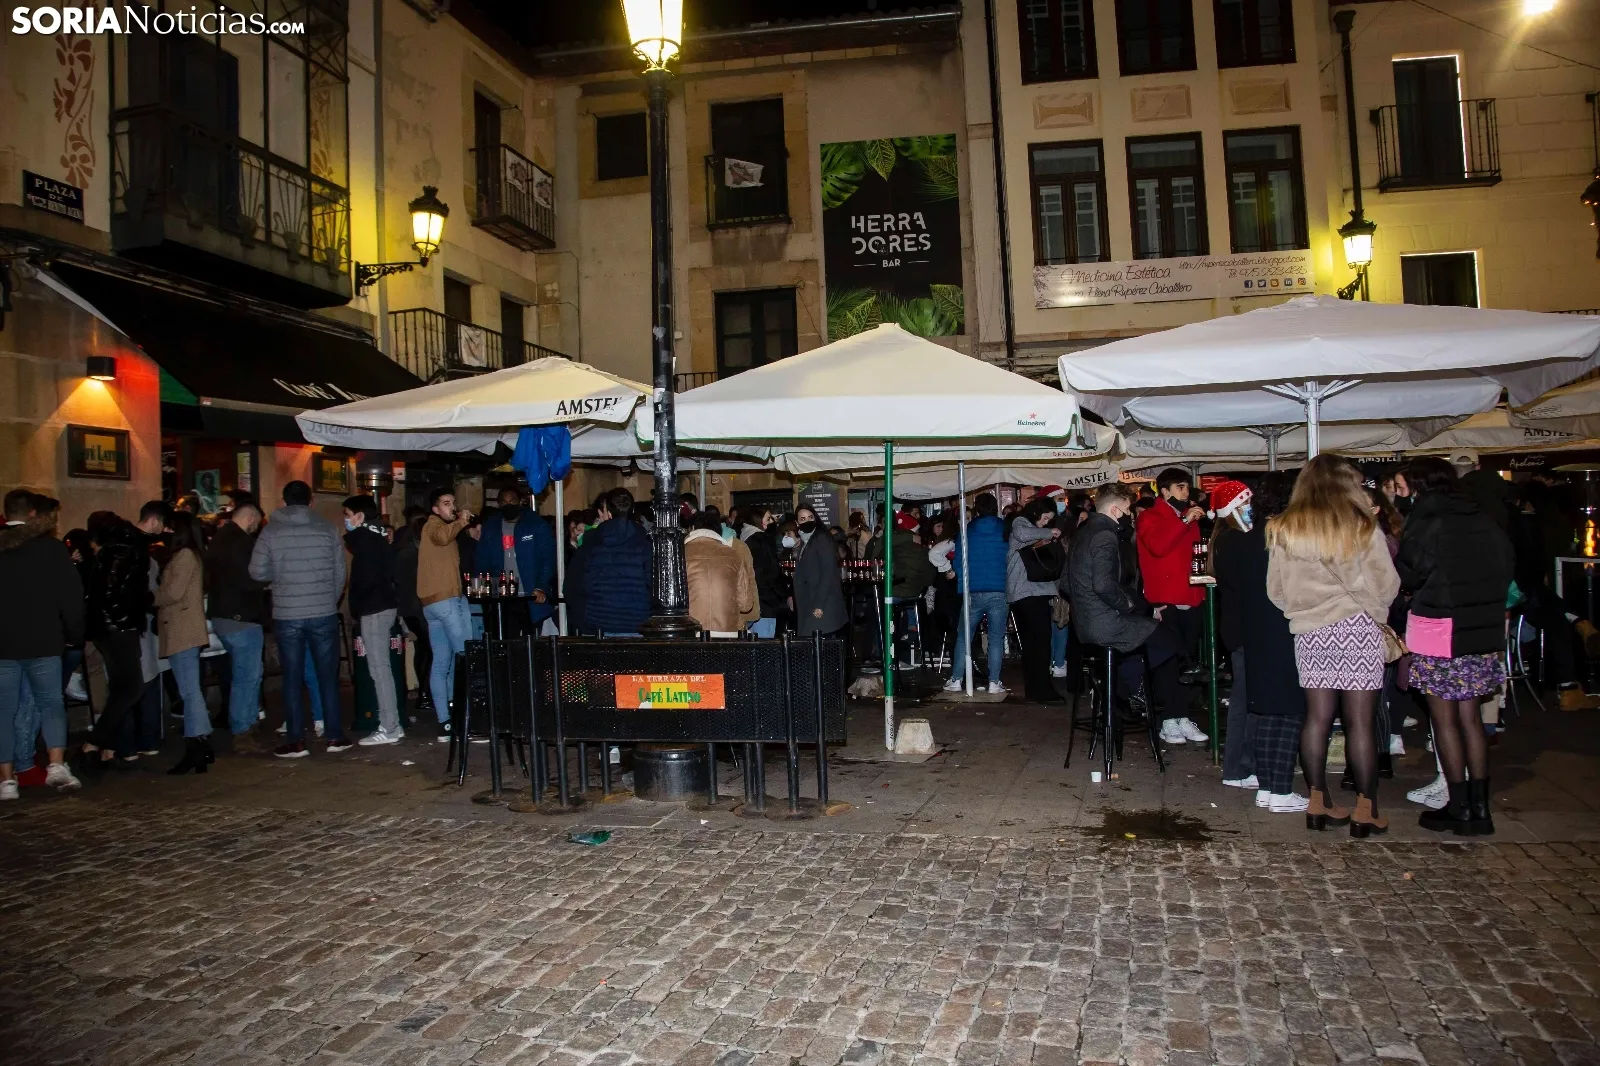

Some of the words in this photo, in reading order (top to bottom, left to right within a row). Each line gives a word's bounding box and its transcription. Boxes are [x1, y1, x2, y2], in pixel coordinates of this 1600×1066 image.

[35, 178, 77, 200] PLAZA
[49, 193, 63, 202] DE
[851, 211, 927, 233] HERRA
[851, 233, 932, 255] DORES
[882, 258, 901, 268] BAR
[1061, 267, 1123, 285] Medicina
[1125, 265, 1171, 280] Estética
[1149, 281, 1193, 296] Caballero
[1066, 471, 1109, 486] AMSTEL
[631, 675, 645, 683] LA
[646, 675, 688, 683] TERRAZA
[638, 687, 663, 703] CAFÉ
[665, 687, 702, 704] LATINO
